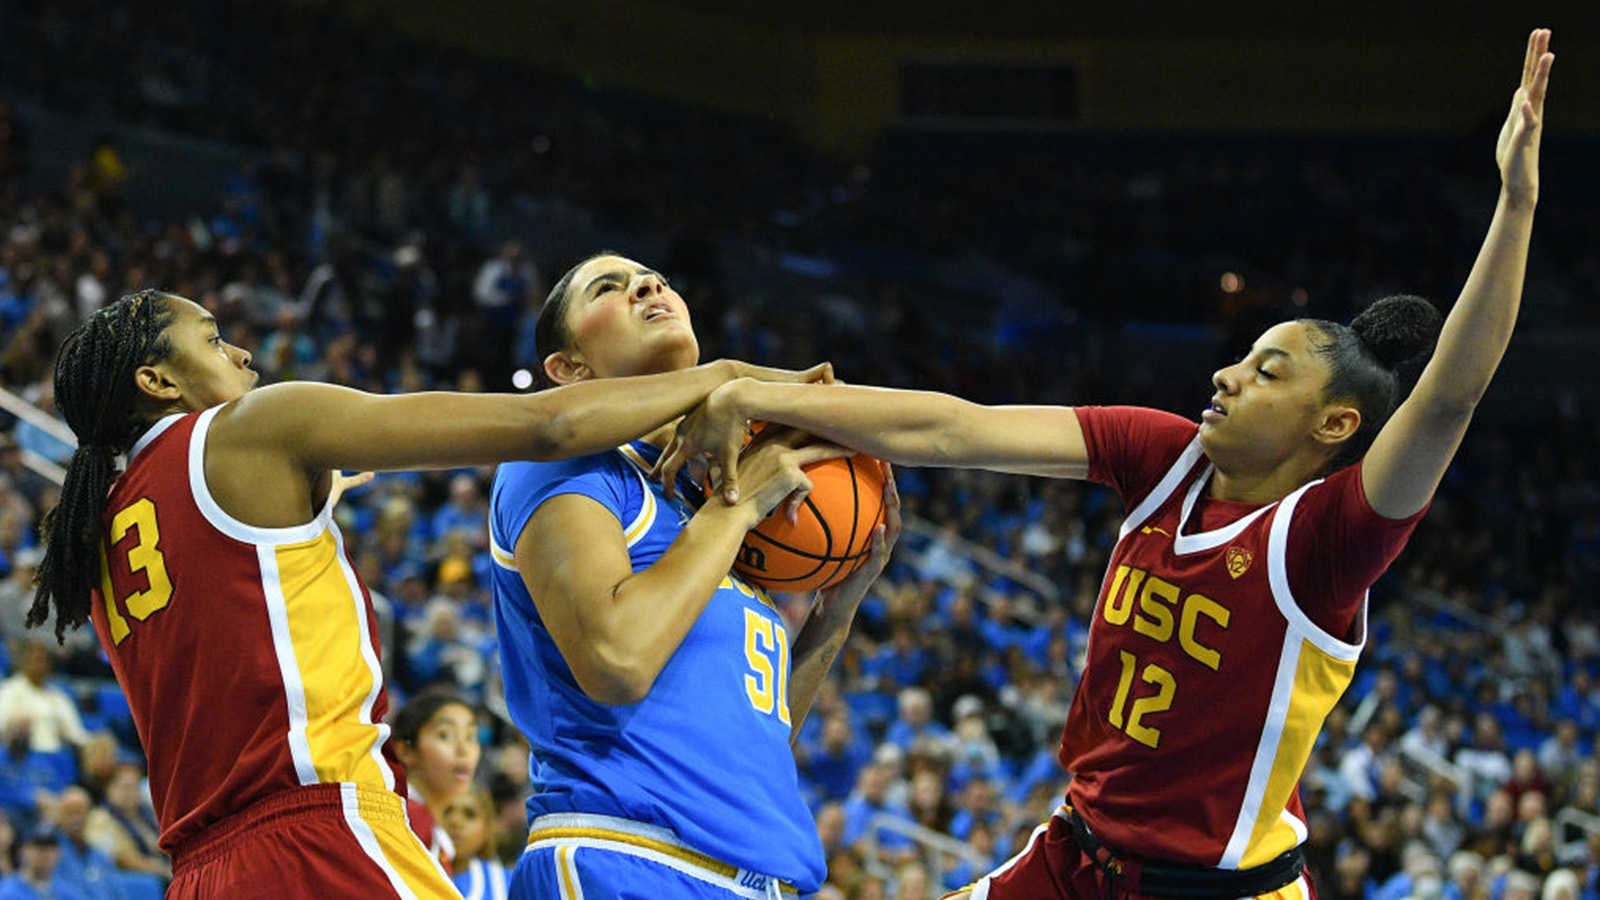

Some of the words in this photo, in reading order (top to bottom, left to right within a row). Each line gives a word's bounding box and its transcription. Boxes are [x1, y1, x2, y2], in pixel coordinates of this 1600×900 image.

[743, 606, 792, 728] 51
[1103, 565, 1231, 671] USC
[1108, 649, 1177, 749] 12
